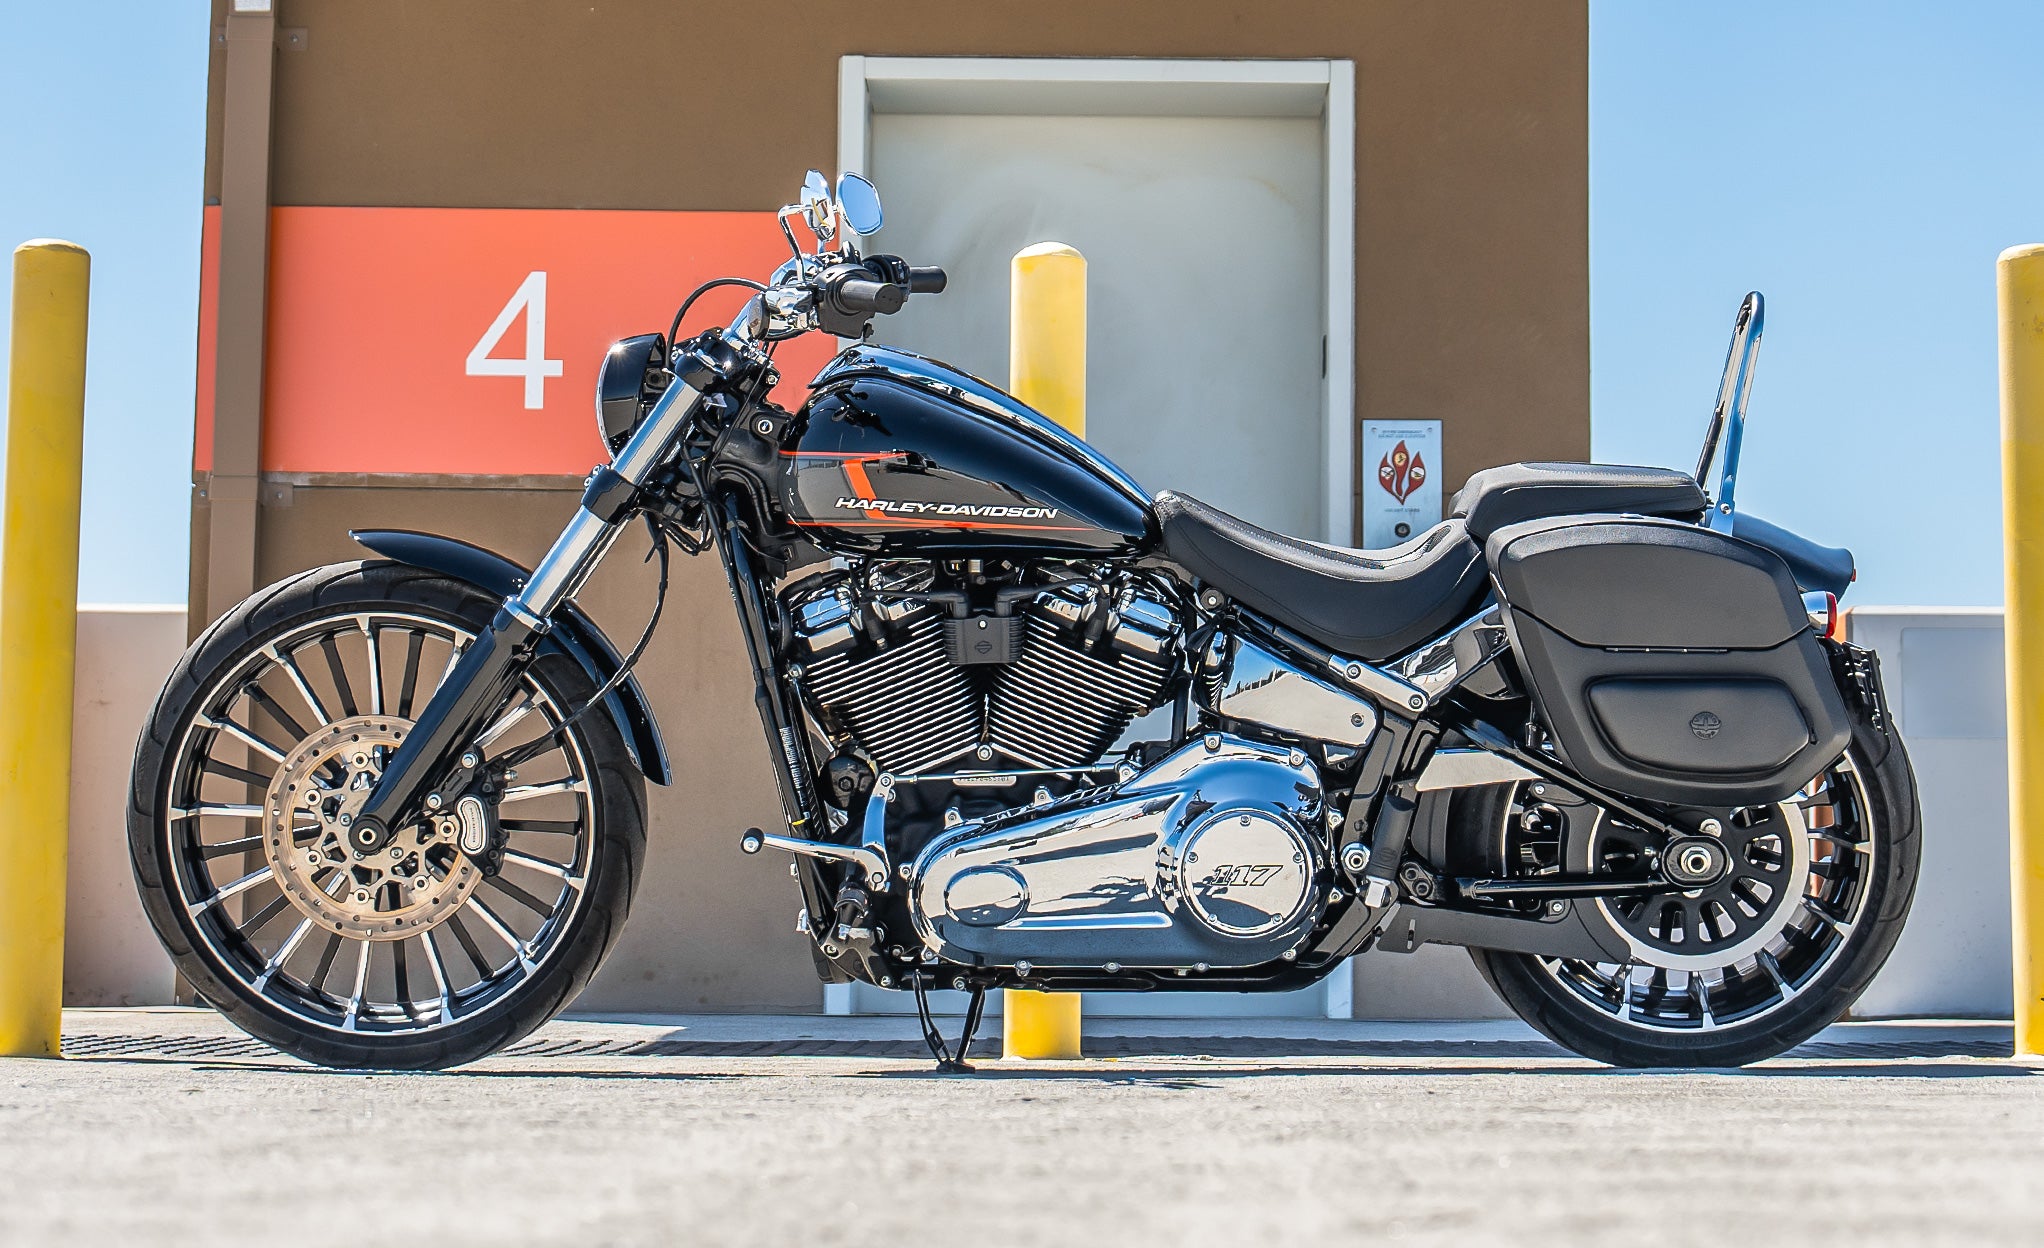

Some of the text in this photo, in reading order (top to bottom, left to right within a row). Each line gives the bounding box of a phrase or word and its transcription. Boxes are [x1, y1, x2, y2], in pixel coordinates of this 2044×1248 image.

[465, 271, 564, 410] 4
[835, 497, 1059, 519] HARLEY-DAVIDSON
[1210, 864, 1284, 887] 117
